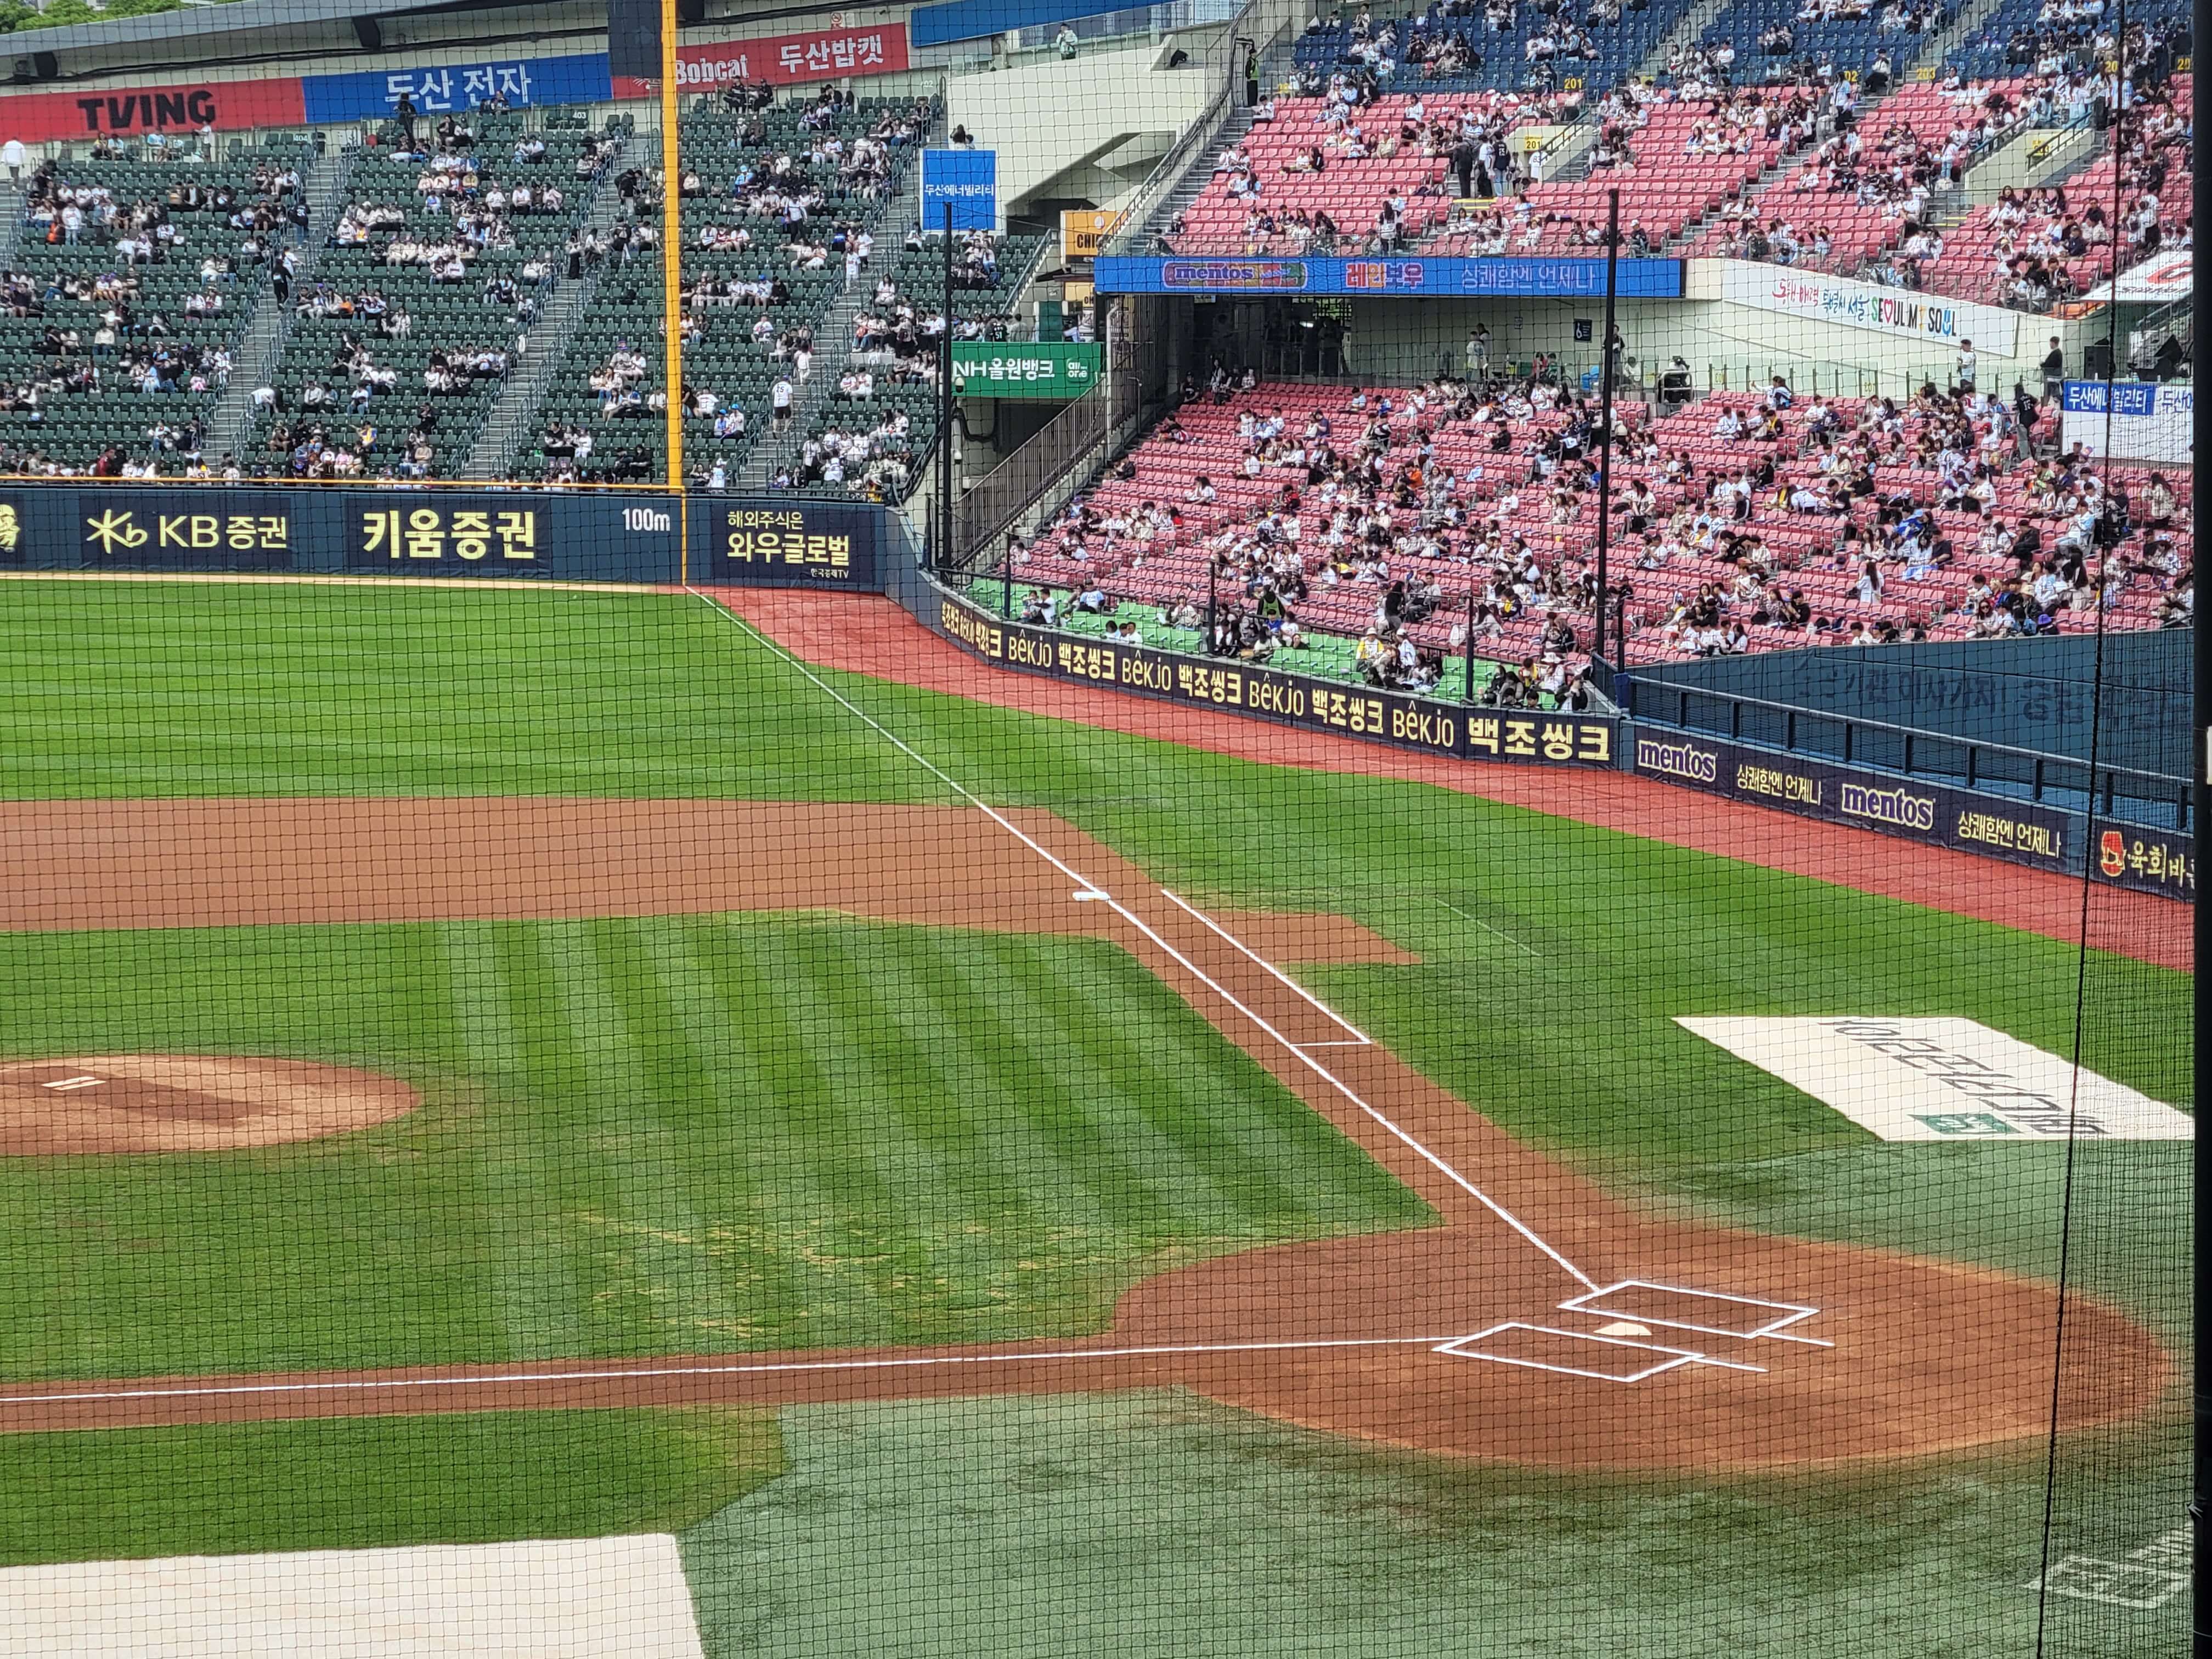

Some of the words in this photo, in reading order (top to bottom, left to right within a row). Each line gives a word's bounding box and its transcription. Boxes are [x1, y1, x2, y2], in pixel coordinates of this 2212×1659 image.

[676, 54, 749, 84] Bobcat
[780, 34, 884, 74] 두산밥캣
[2105, 60, 2118, 72] 20
[386, 71, 452, 111] 두산
[463, 64, 532, 106] 전자
[1564, 78, 1583, 89] 201
[1844, 70, 1858, 82] 02
[77, 91, 215, 131] TVING
[1526, 140, 1541, 149] 201
[924, 184, 994, 196] 두산에너빌리티
[1175, 263, 1256, 280] mentos
[1346, 262, 1423, 289] 레인보우
[1538, 264, 1596, 290] 언제나
[1928, 307, 1957, 337] SOUL
[363, 509, 535, 560] 키움증권
[622, 508, 670, 532] 100m
[727, 510, 804, 530] 해외주식은
[727, 532, 849, 567] 와우글로벌
[810, 567, 849, 579] 한국경제TV
[1058, 642, 1115, 681] 백조씽크
[1178, 663, 1242, 704] 백조씽크
[1312, 689, 1384, 735] 백조씽크
[1469, 716, 1610, 761] 백조씽크
[1638, 740, 1716, 782] mentos
[1736, 763, 1783, 796] 상쾌함엔
[1785, 775, 1822, 806] 언제나
[1842, 783, 1933, 831] mentos
[1958, 811, 2015, 848] 상쾌함엔
[2017, 823, 2062, 859] 언제나
